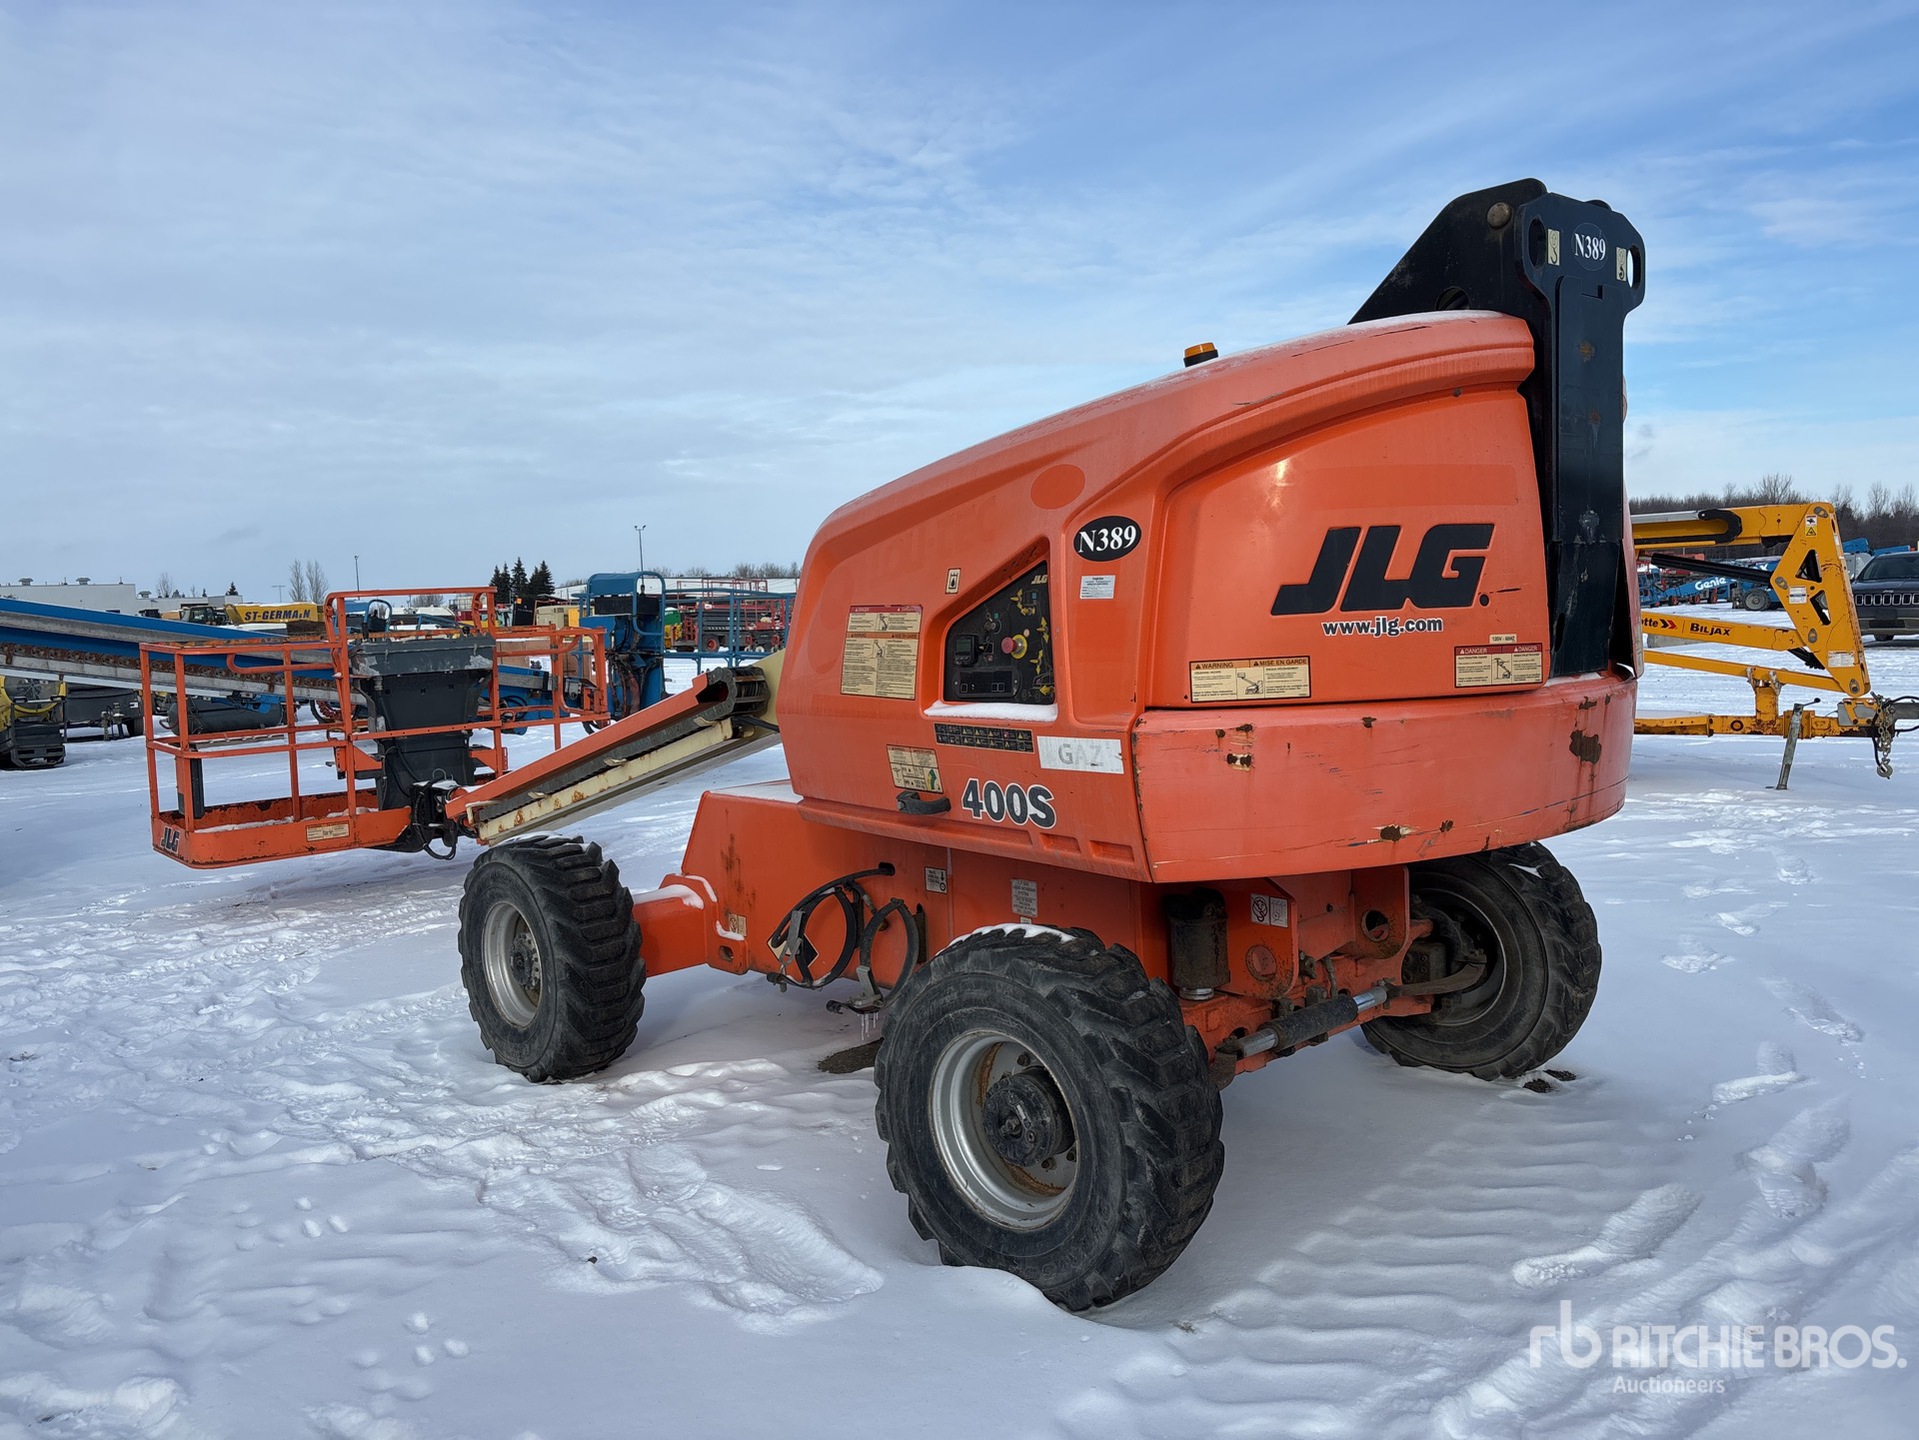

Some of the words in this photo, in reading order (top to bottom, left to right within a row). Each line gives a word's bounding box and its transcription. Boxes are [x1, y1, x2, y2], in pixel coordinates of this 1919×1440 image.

[1574, 233, 1606, 261] N389
[1078, 525, 1137, 553] N389
[1271, 523, 1495, 616] JLG
[1694, 577, 1727, 591] Genie
[1322, 616, 1443, 637] www.jlg.com
[1689, 622, 1731, 637] BILJAX
[1464, 647, 1488, 655] DANGER
[1202, 661, 1234, 670] WARNING
[1275, 658, 1285, 666] EN
[962, 778, 1056, 829] 400S
[160, 826, 181, 852] JLG
